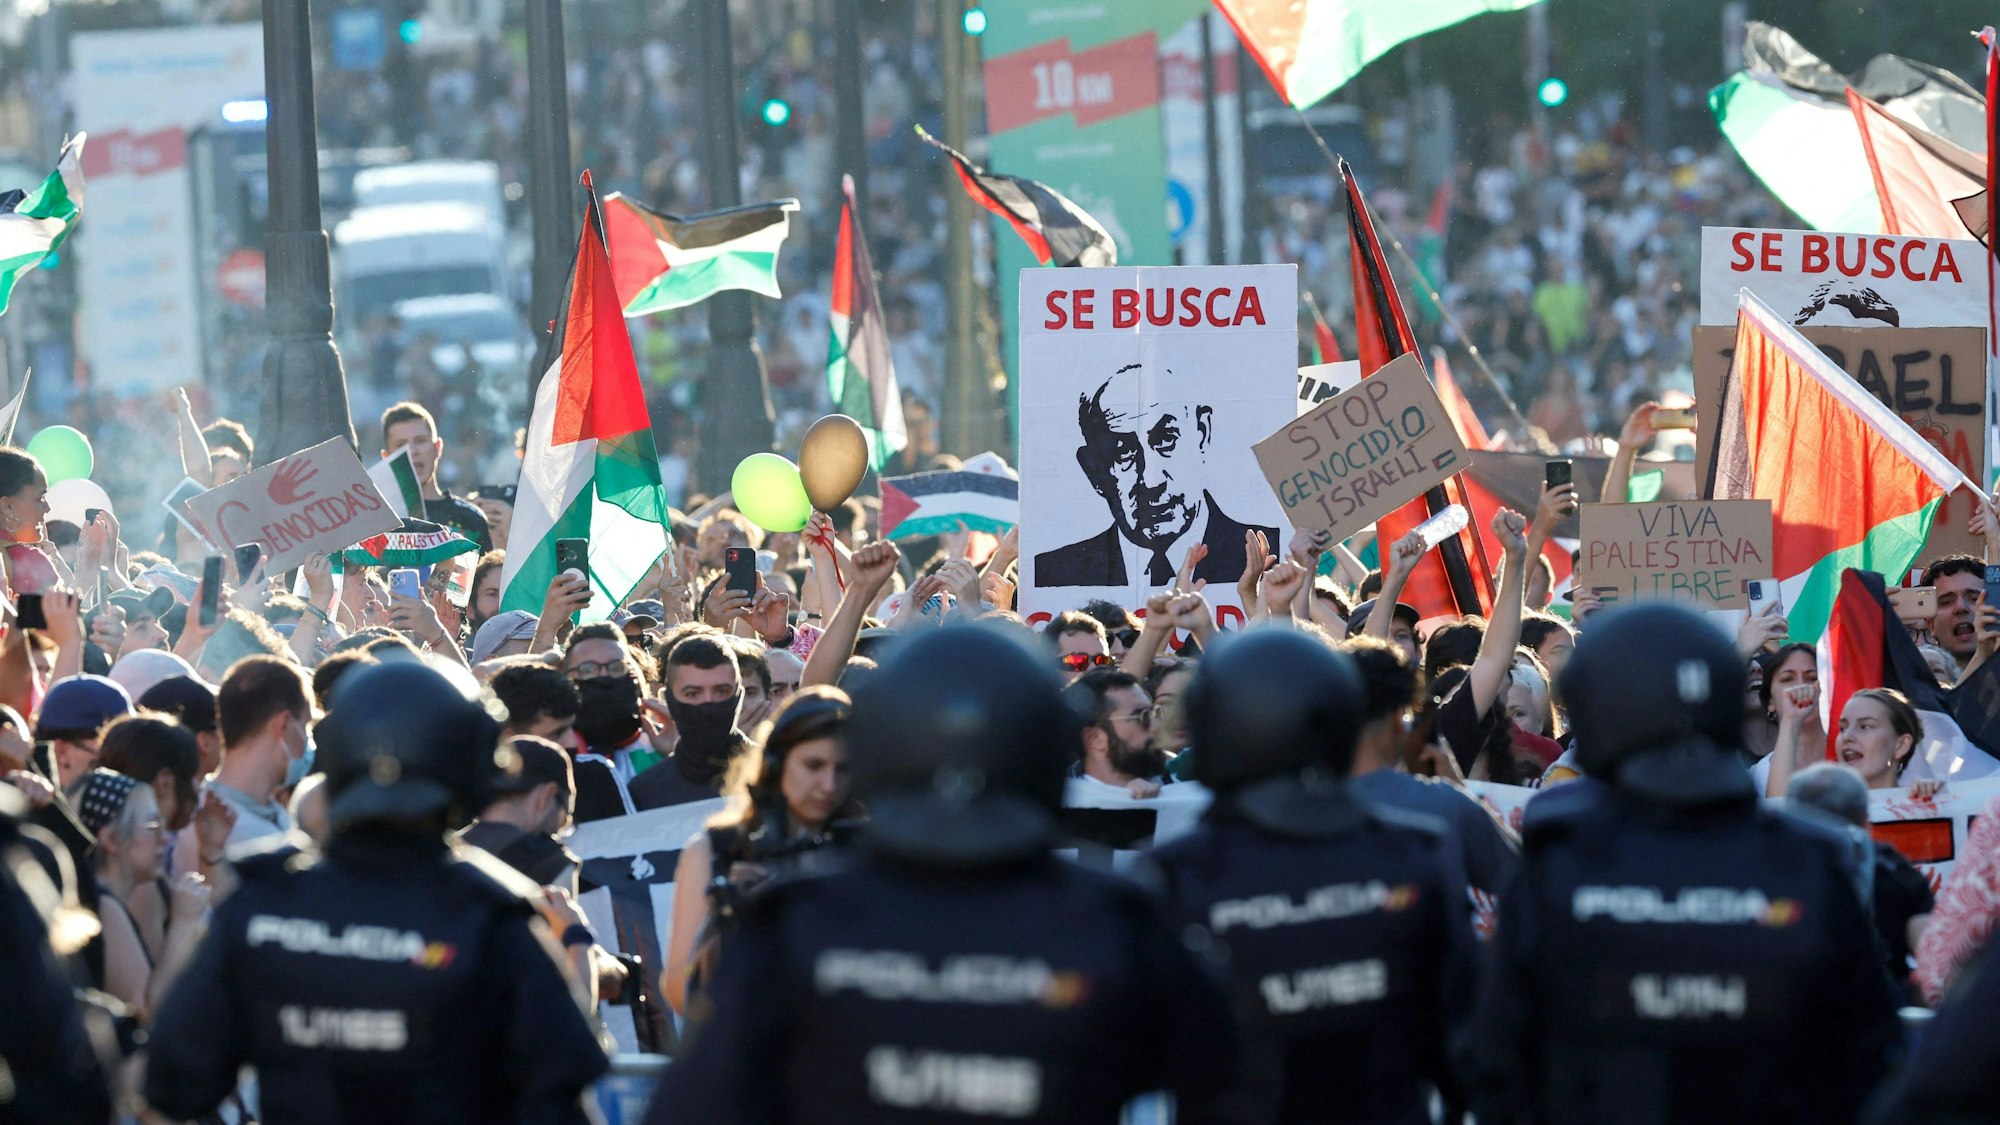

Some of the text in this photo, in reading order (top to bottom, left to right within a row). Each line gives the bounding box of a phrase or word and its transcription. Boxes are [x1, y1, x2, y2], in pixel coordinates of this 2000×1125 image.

[1032, 61, 1074, 109] 10
[1731, 232, 1963, 283] SE BUSCA
[1044, 286, 1266, 330] SE BUSCA
[1288, 380, 1389, 461] STOP
[1279, 405, 1426, 509] GENOCIDIO
[1315, 445, 1428, 528] ISRAELI
[1638, 504, 1724, 538] VIVA
[1589, 537, 1763, 571] PALESTINA
